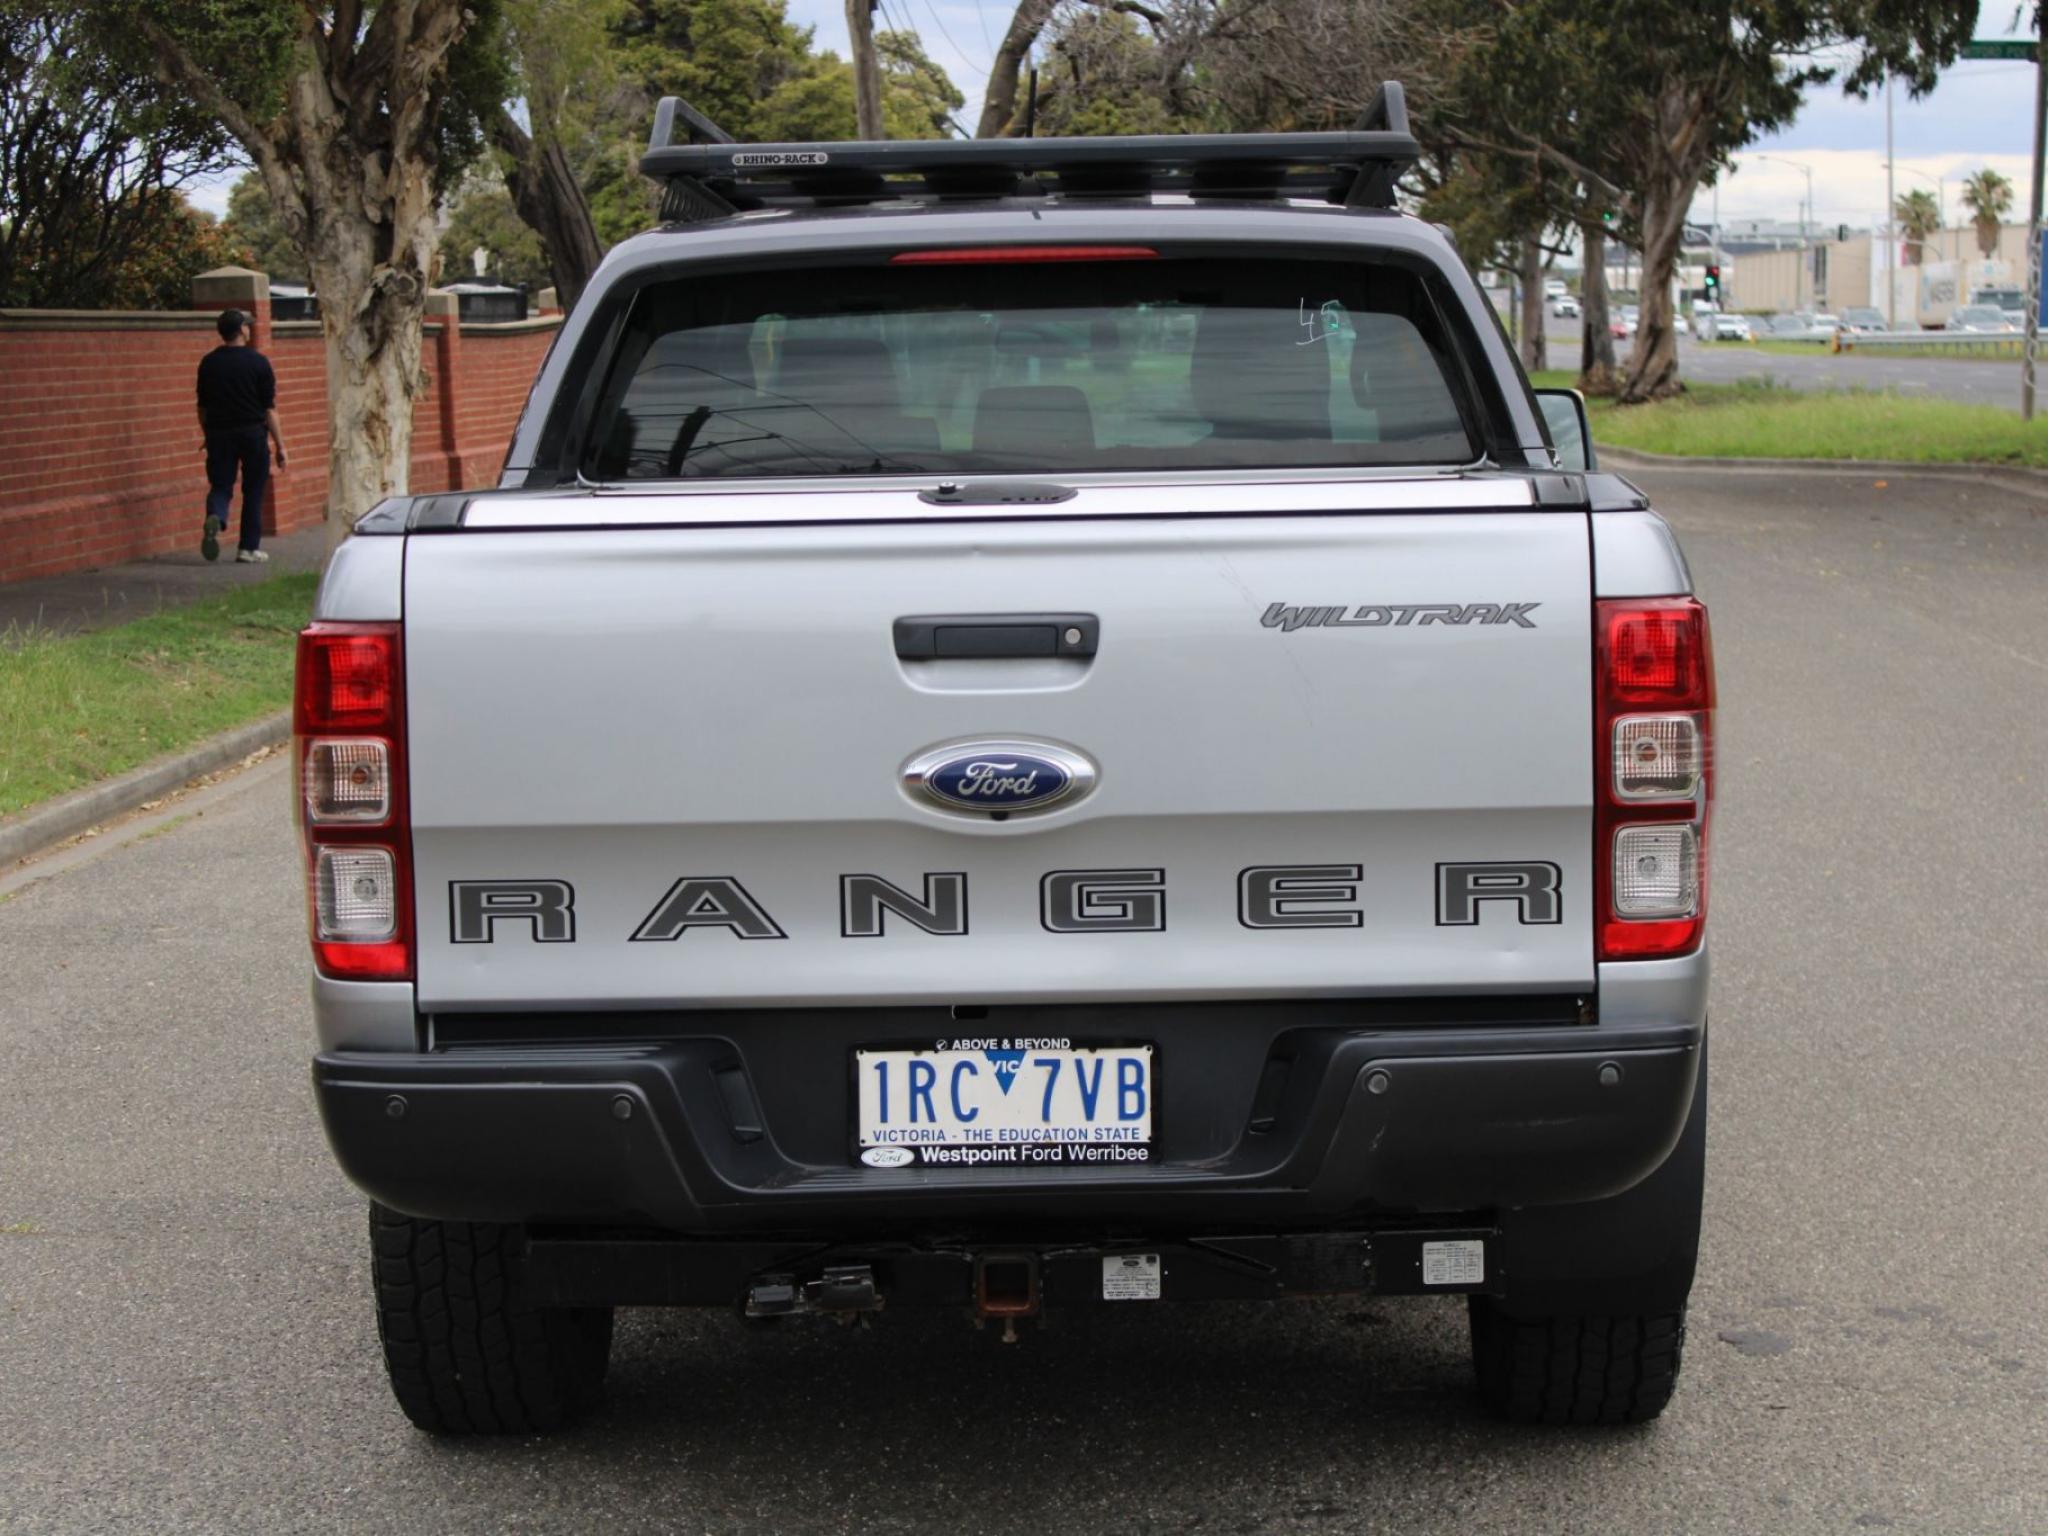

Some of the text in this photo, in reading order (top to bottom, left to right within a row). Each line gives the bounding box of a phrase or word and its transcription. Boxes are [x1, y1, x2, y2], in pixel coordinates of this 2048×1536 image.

[743, 153, 817, 165] RHINO-RACK
[1260, 602, 1543, 632] WILDTRAK
[957, 761, 1038, 796] Ford
[448, 861, 1563, 944] RANGER
[952, 1038, 1071, 1050] ABOVE & BEYOND
[989, 1060, 1020, 1074] VIC
[873, 1058, 1146, 1123] 1RC 7VB
[873, 1129, 946, 1142] VICTORIA
[963, 1128, 993, 1142] THE
[999, 1127, 1088, 1142] EDUCATION
[1094, 1127, 1140, 1141] STATE
[872, 1149, 904, 1163] Ford
[921, 1144, 1149, 1165] Westpoint Ford Werribee
